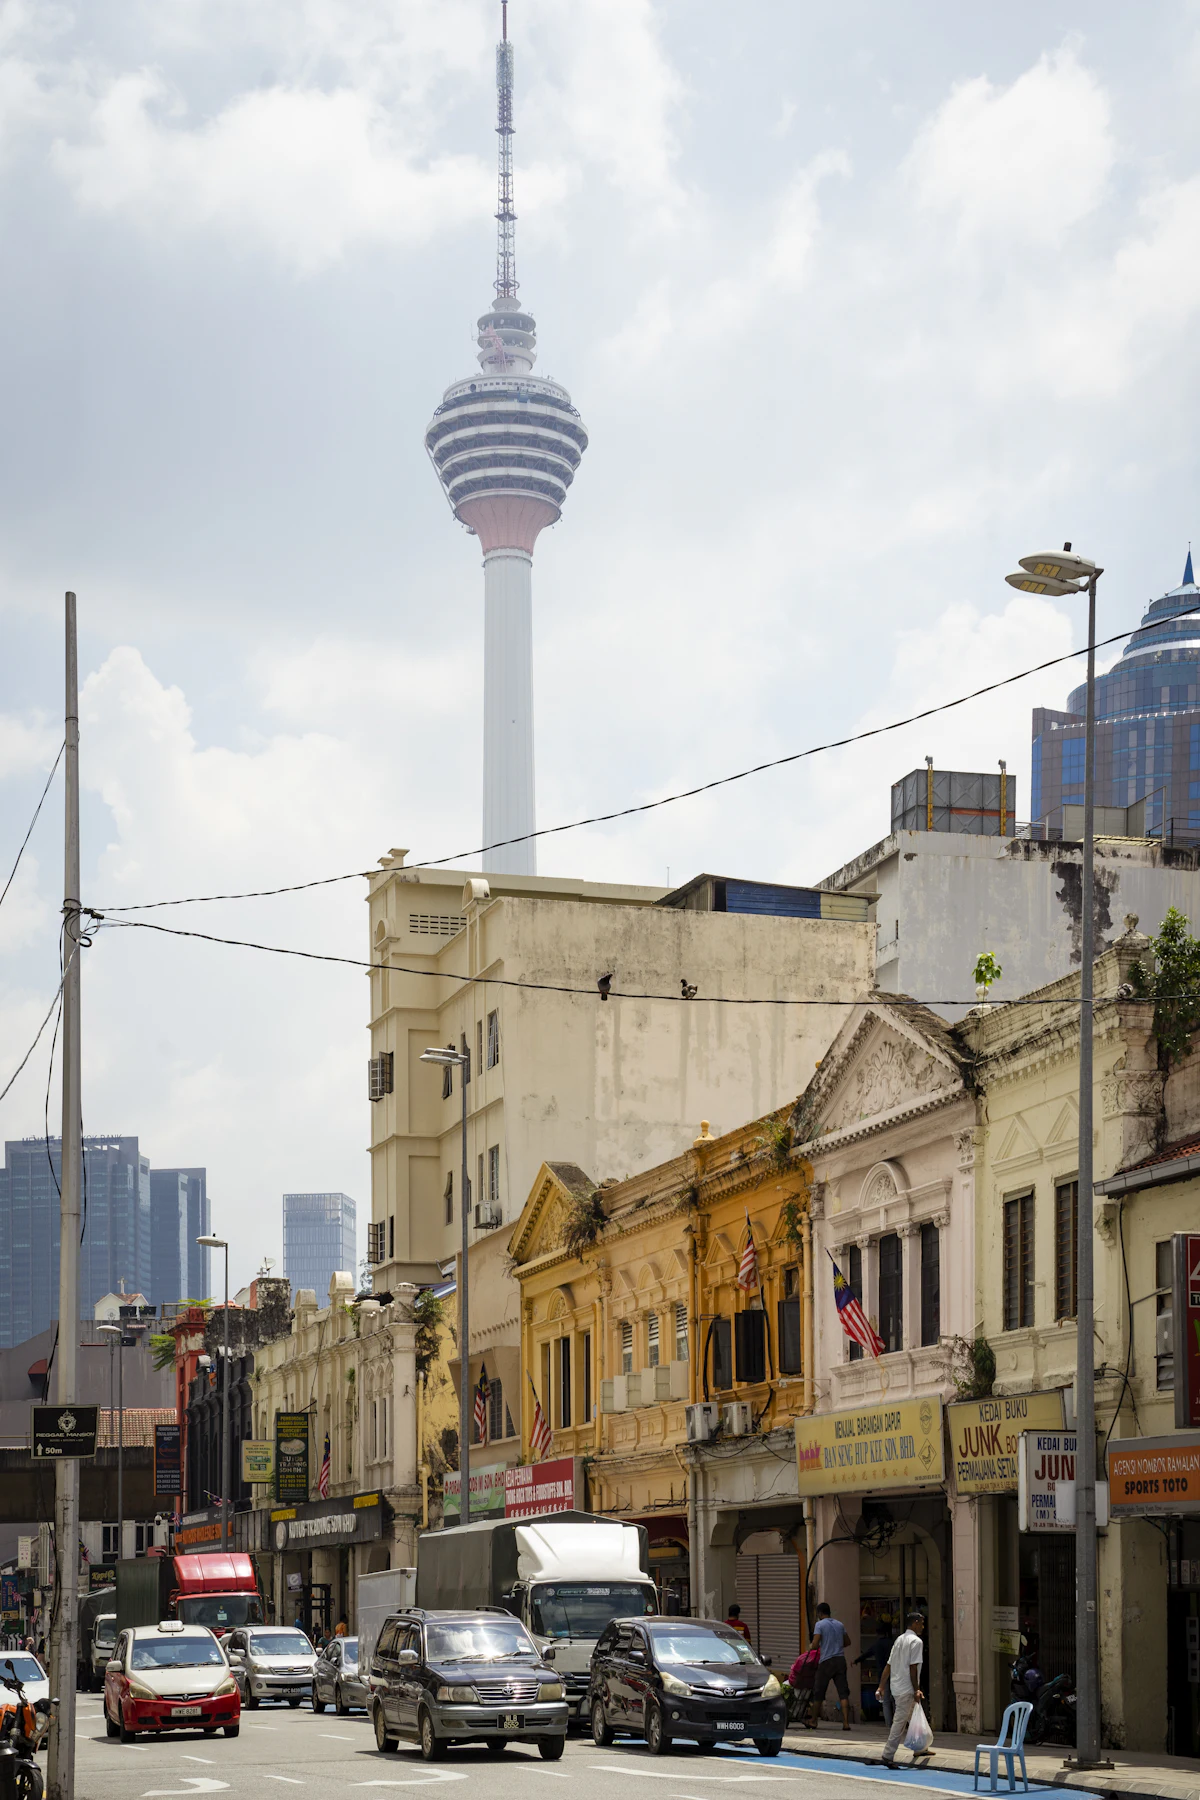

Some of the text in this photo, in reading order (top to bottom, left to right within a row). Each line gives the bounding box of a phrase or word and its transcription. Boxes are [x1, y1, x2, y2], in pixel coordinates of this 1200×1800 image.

[979, 1399, 1028, 1422] KEDAI BUKU
[835, 1411, 901, 1439] MENJUAL BARANGAN DAPUR
[959, 1424, 1018, 1458] JUNK BO
[1037, 1437, 1077, 1451] KEDAI BU
[824, 1445, 837, 1468] BAN
[838, 1444, 853, 1467] SENG
[855, 1442, 868, 1465] HUP
[870, 1439, 883, 1463] KEE
[998, 1457, 1017, 1479] SETIA
[1035, 1455, 1077, 1481] JUN
[1114, 1454, 1200, 1476] AGENSI NOMBOR RAMALAN
[1047, 1482, 1056, 1491] BO
[1125, 1478, 1188, 1495] SPORTS TOTO
[1031, 1494, 1056, 1508] PERMAI
[1036, 1509, 1050, 1519] (M)
[716, 1722, 745, 1730] WWH 6003
